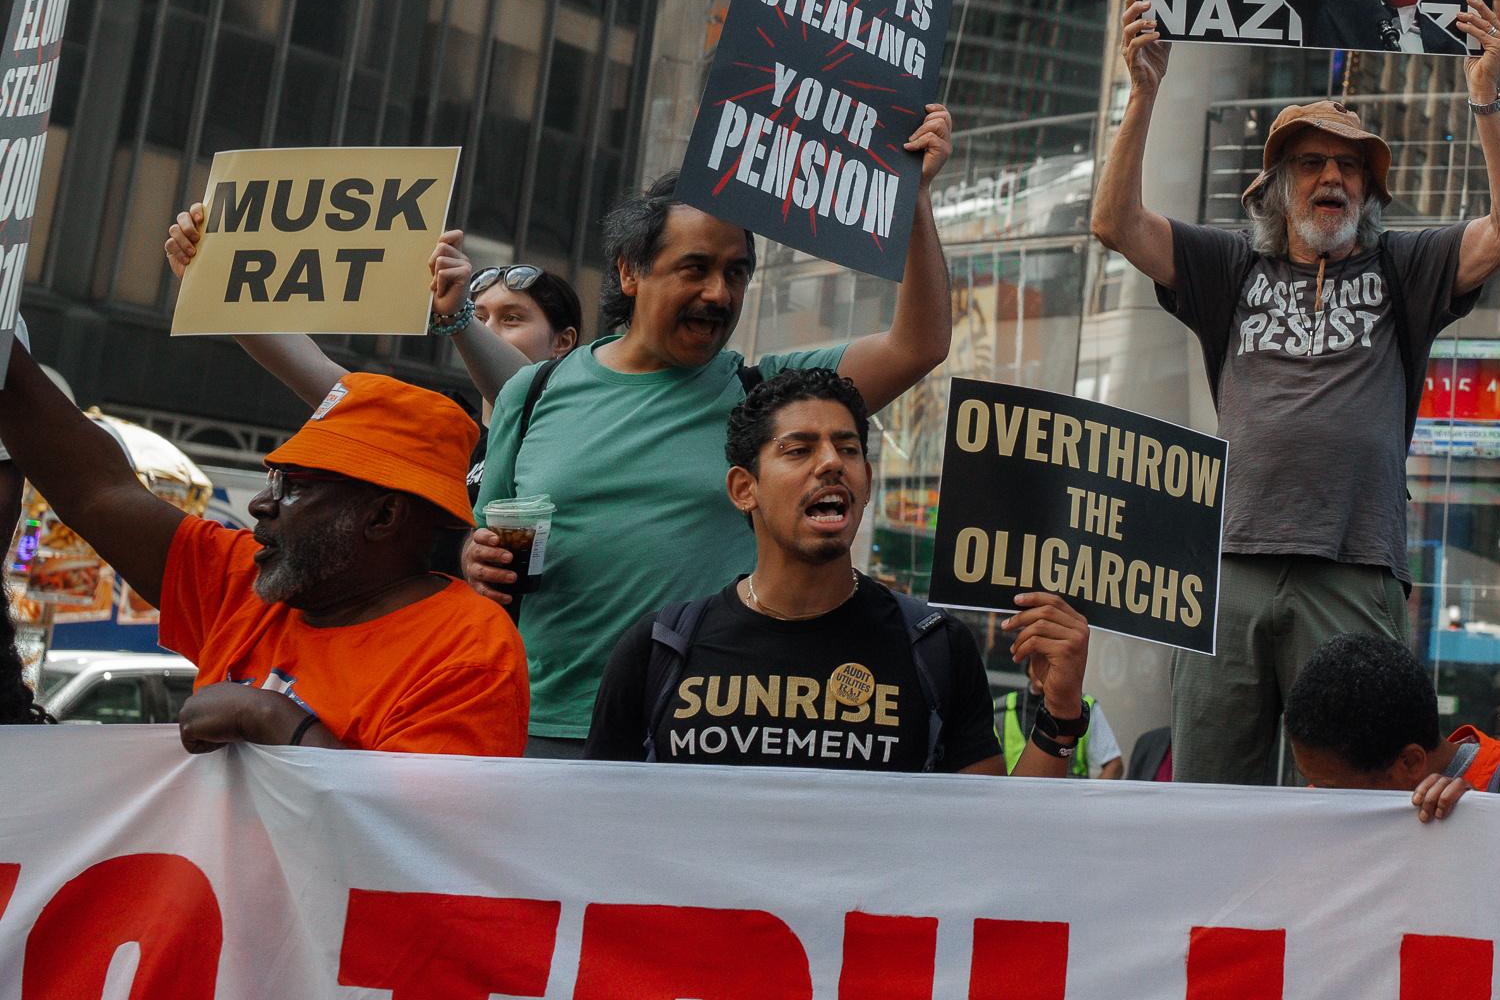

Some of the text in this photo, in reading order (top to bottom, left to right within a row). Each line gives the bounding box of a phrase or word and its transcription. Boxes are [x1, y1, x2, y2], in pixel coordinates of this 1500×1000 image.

[771, 62, 879, 150] YOUR
[707, 100, 900, 238] PENSION
[205, 178, 437, 233] MUSK
[224, 248, 385, 302] RAT
[1247, 272, 1383, 314] RISE AND
[1237, 307, 1381, 357] RESIST
[956, 399, 1221, 507] OVERTHROW
[1066, 486, 1126, 541] THE
[954, 527, 1204, 628] OLIGARCHS
[836, 672, 871, 693] UTILITIES
[843, 665, 871, 683] AUDIT
[669, 726, 900, 763] MOVEMENT
